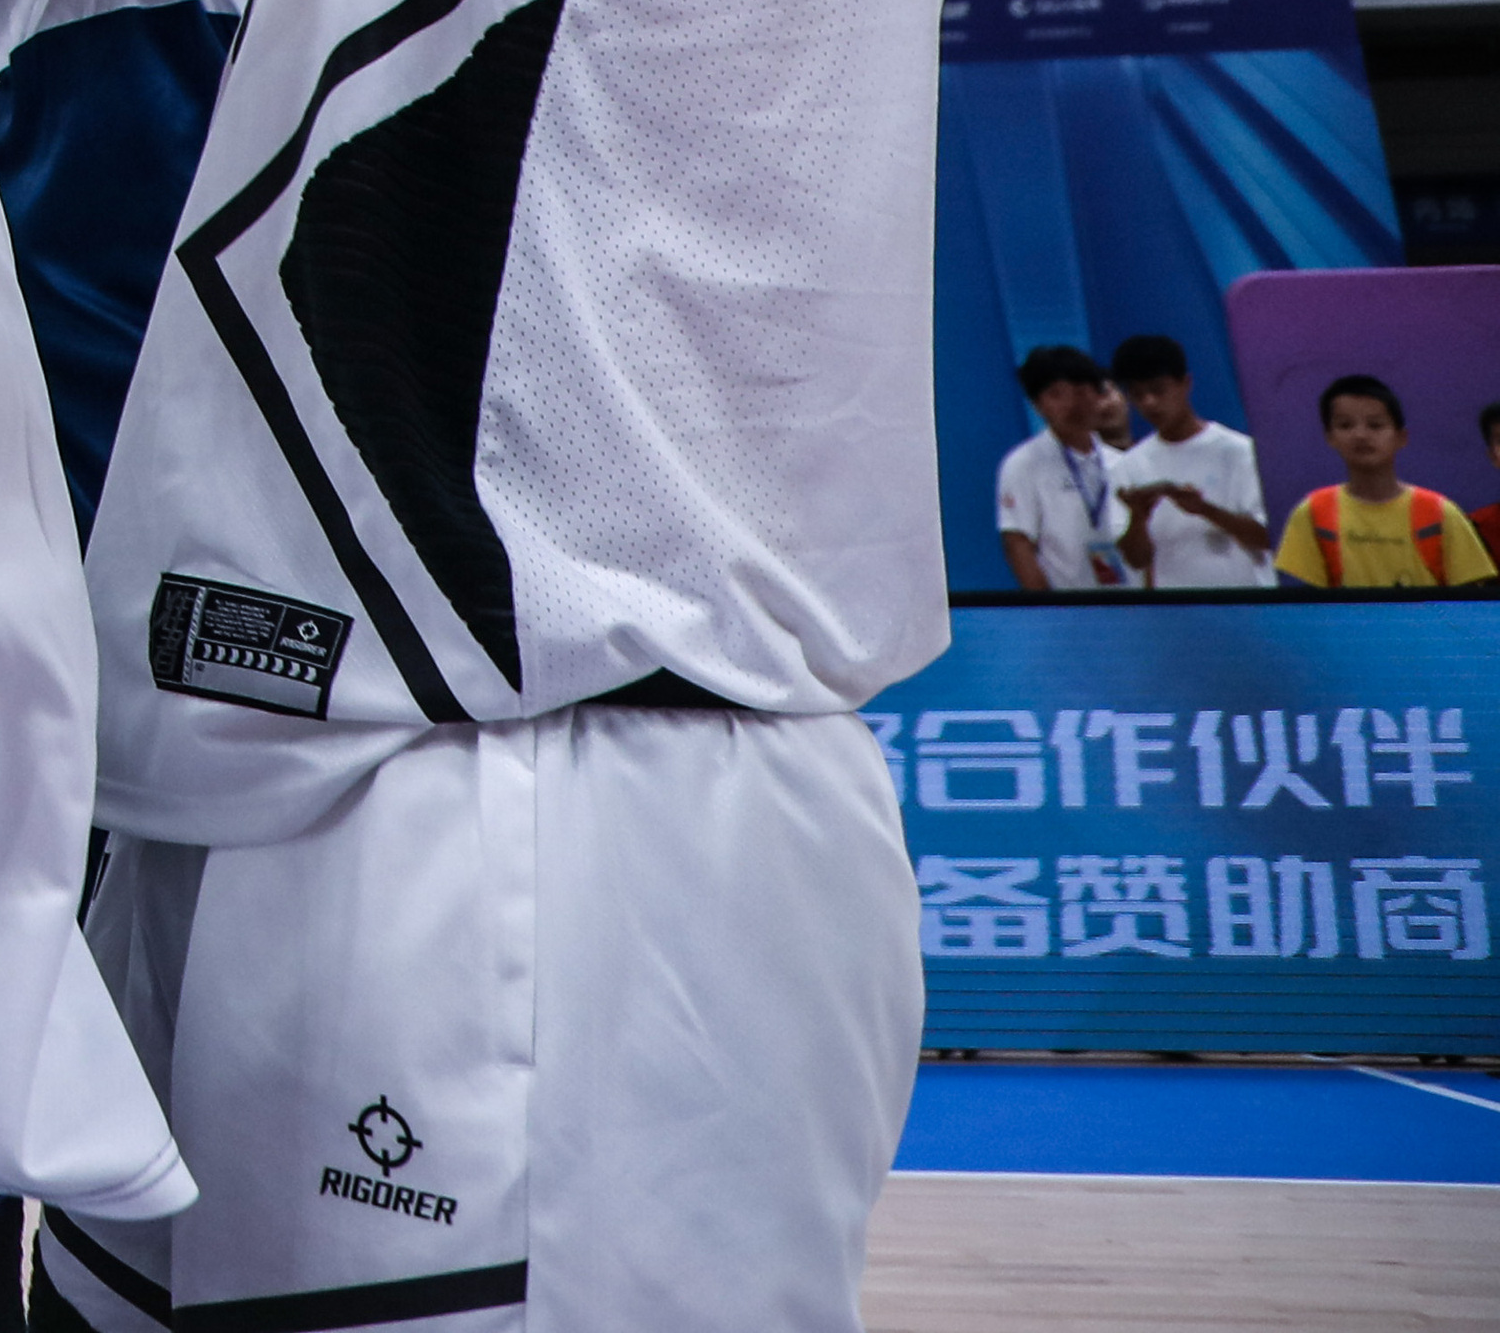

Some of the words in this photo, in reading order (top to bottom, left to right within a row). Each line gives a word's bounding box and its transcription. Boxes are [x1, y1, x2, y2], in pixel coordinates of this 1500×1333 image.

[916, 854, 1491, 960] 备赞助商
[319, 1166, 458, 1225] RIGORER
